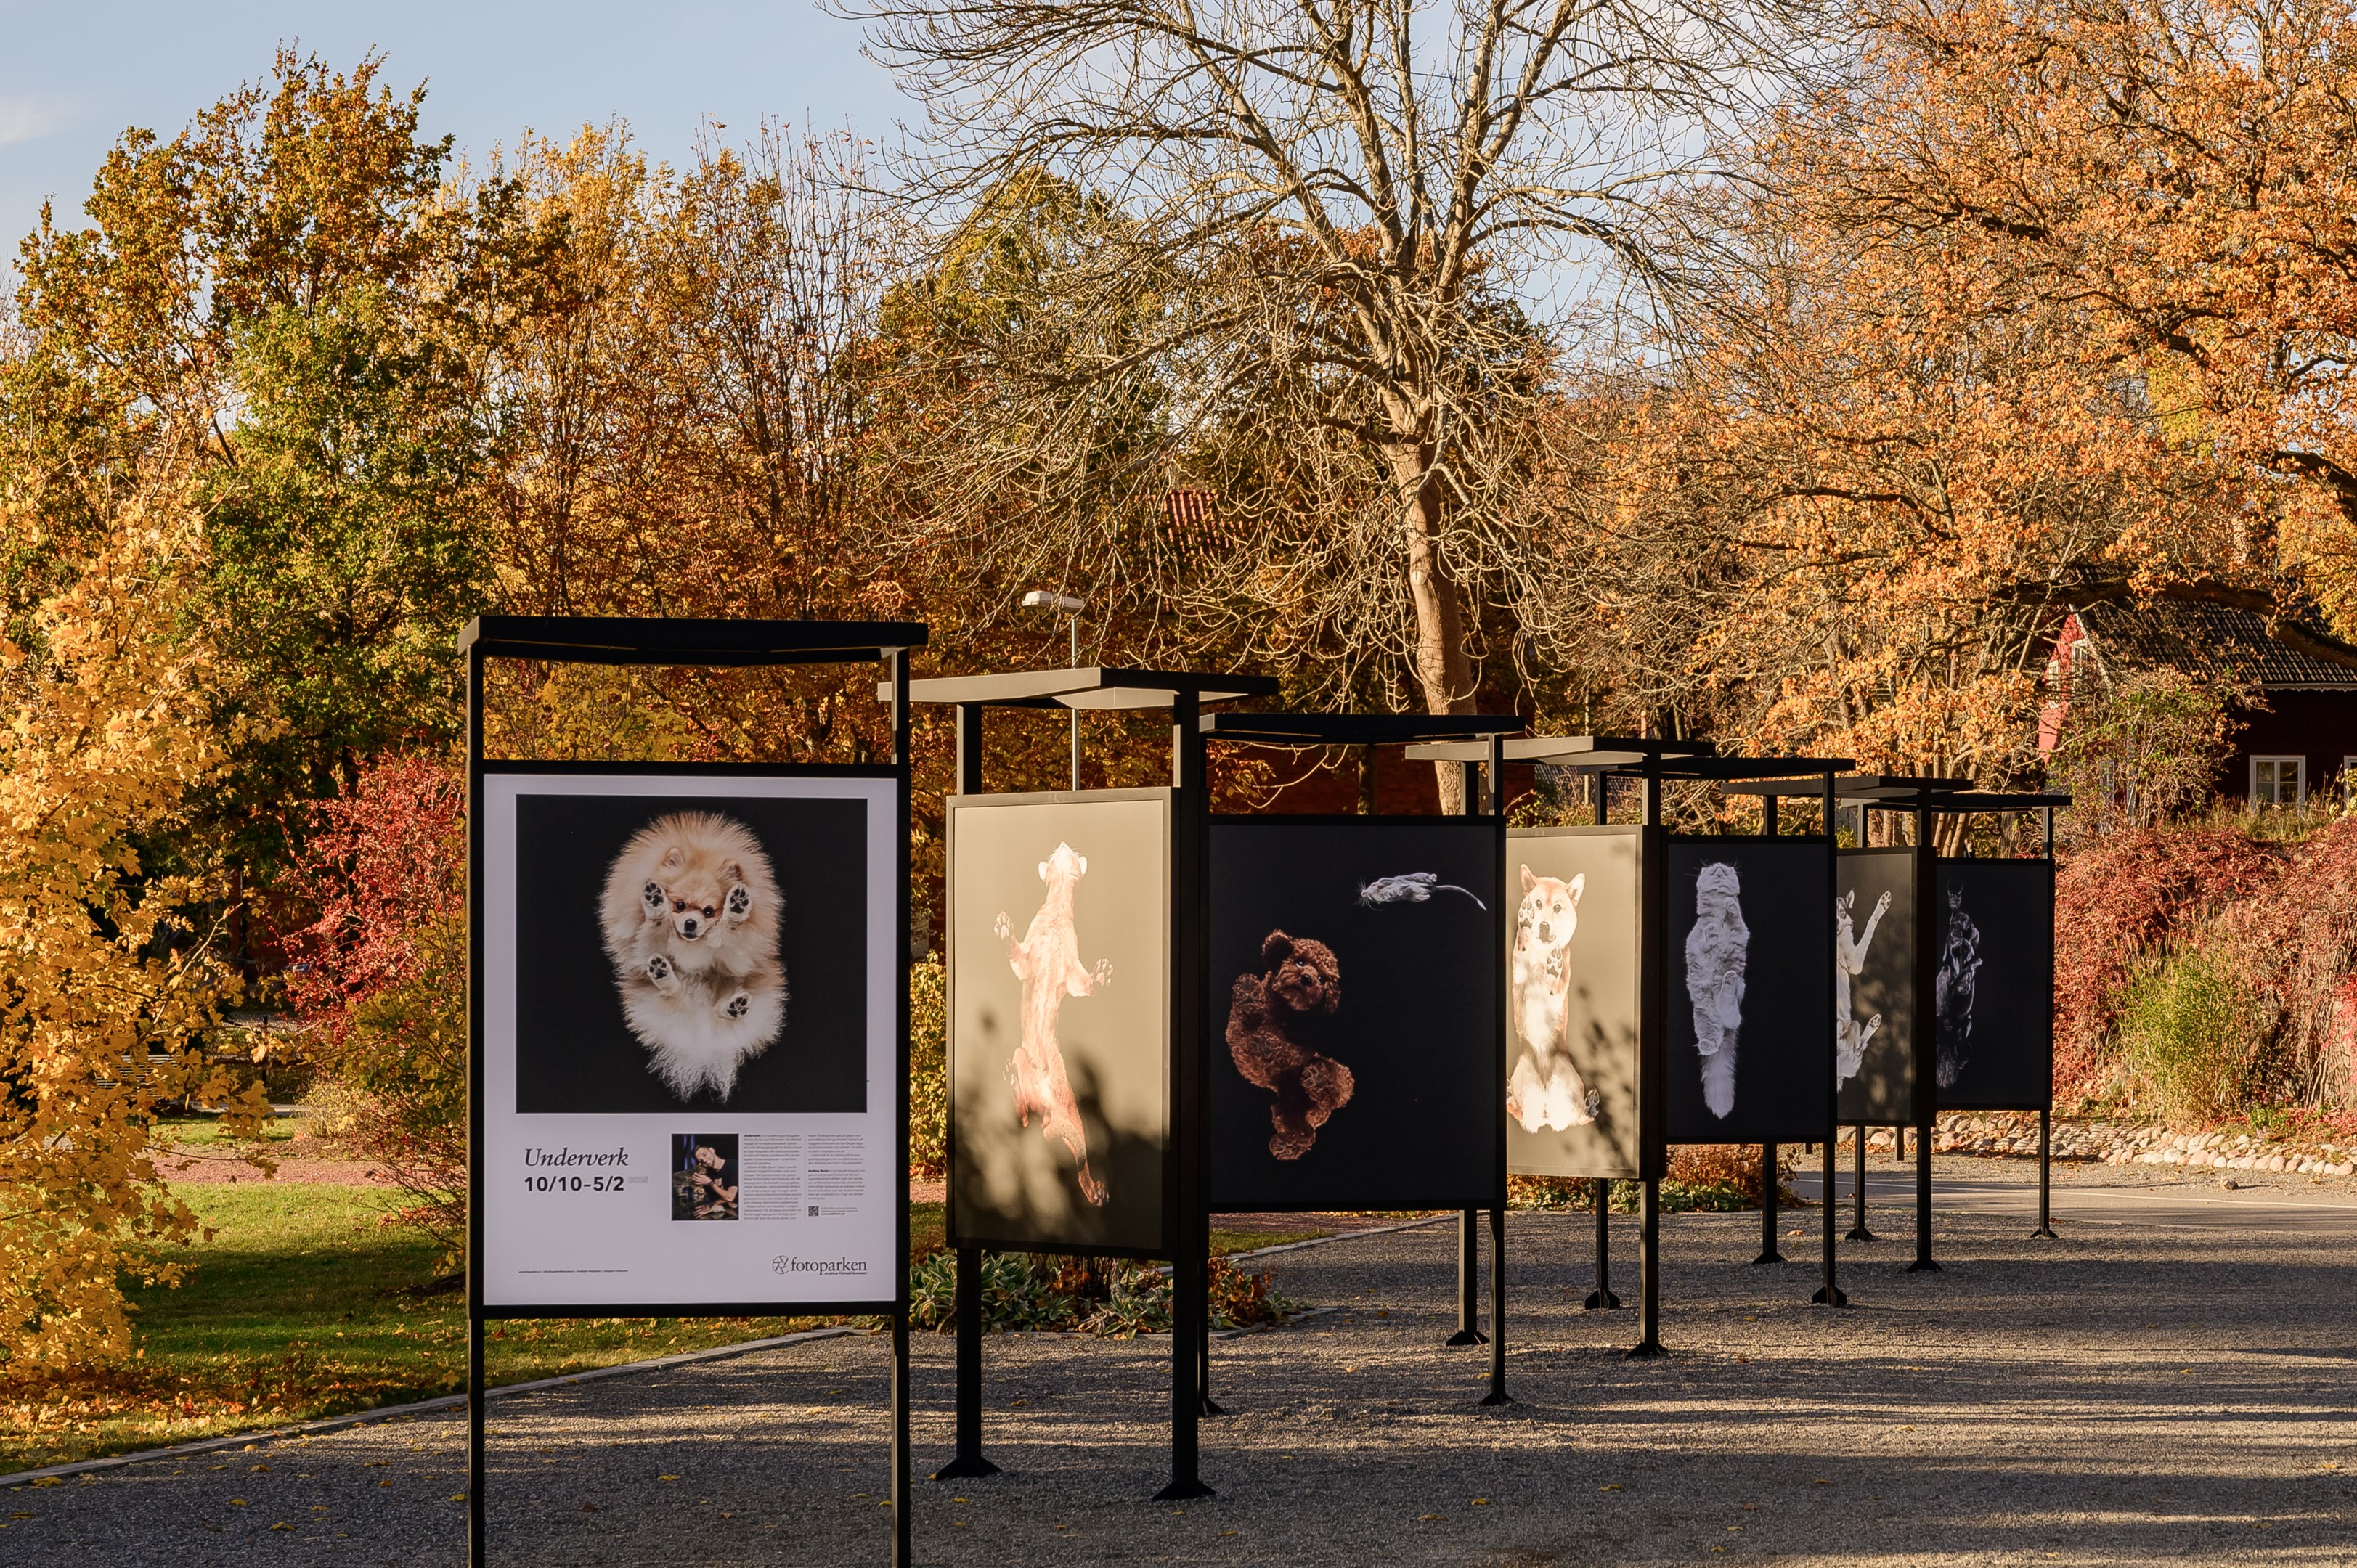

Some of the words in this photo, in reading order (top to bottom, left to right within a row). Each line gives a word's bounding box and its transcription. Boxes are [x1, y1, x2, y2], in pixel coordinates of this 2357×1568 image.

[524, 1147, 629, 1167] Underverk
[524, 1176, 624, 1192] 10/10-5/2
[791, 1257, 867, 1275] fotoparken
